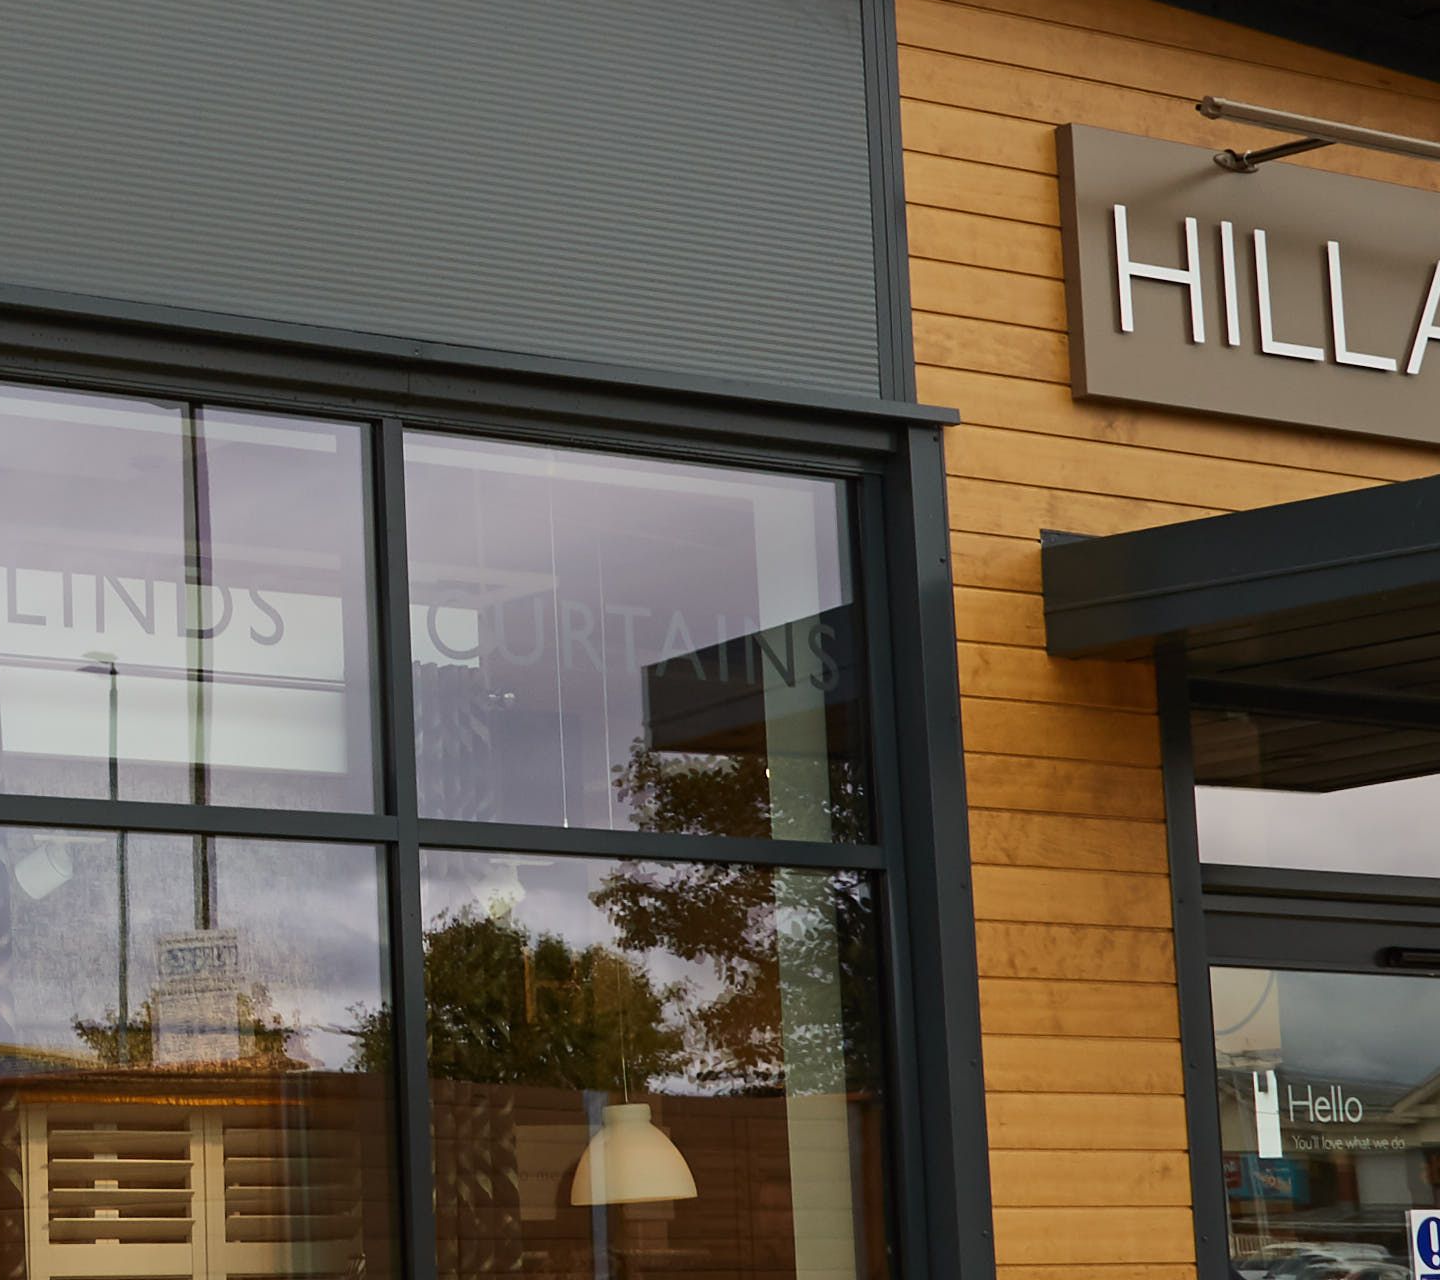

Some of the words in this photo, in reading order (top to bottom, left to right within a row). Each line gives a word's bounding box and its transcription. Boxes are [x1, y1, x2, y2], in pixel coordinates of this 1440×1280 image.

[427, 590, 840, 692] CURTAINS
[1287, 1084, 1363, 1123] Hello
[1321, 1135, 1343, 1150] love
[1344, 1136, 1370, 1150] what
[1372, 1138, 1389, 1150] we
[1391, 1136, 1405, 1150] do
